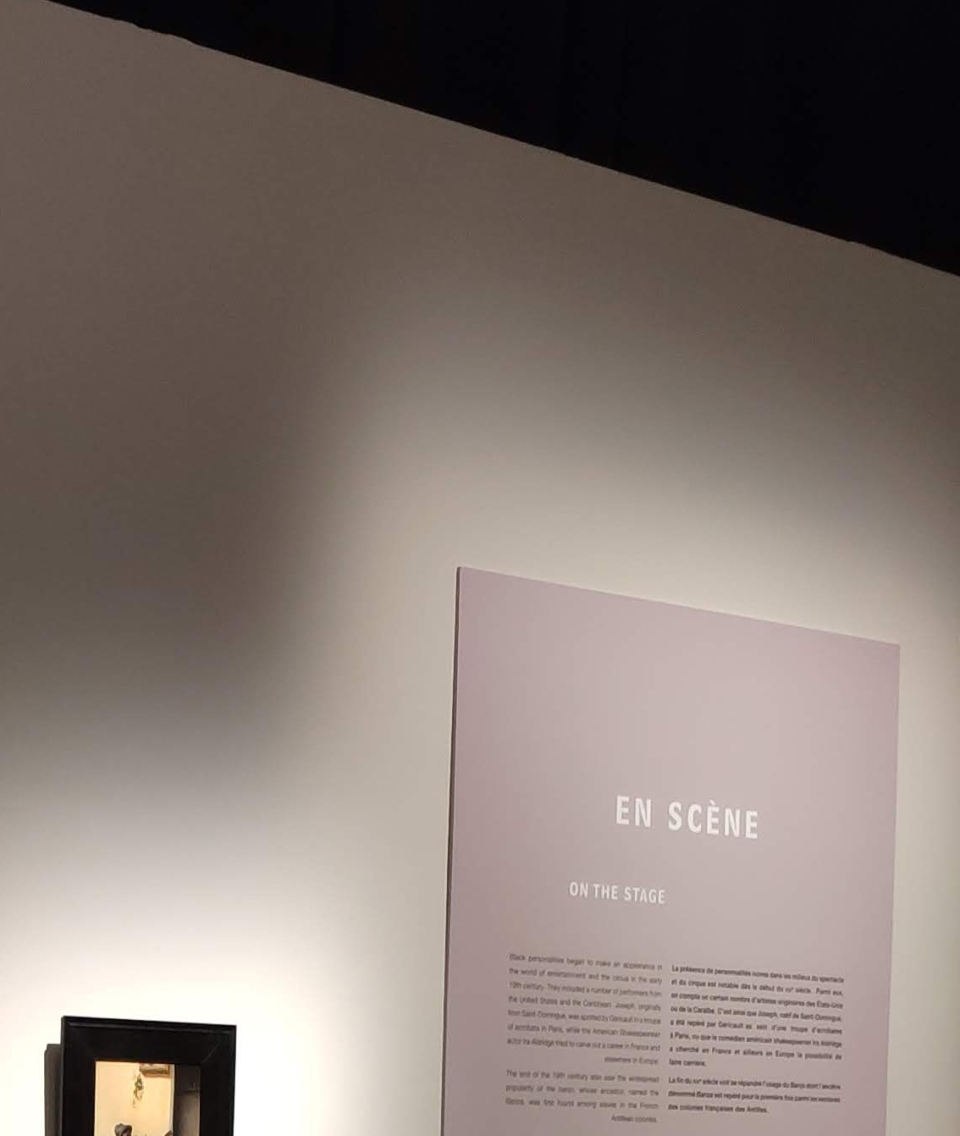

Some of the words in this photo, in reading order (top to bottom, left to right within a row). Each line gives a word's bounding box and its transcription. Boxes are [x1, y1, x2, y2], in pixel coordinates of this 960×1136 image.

[616, 795, 652, 828] EN
[668, 800, 758, 839] SCÈNE
[569, 881, 589, 899] ON
[593, 883, 619, 900] THE
[623, 886, 666, 905] STAGE
